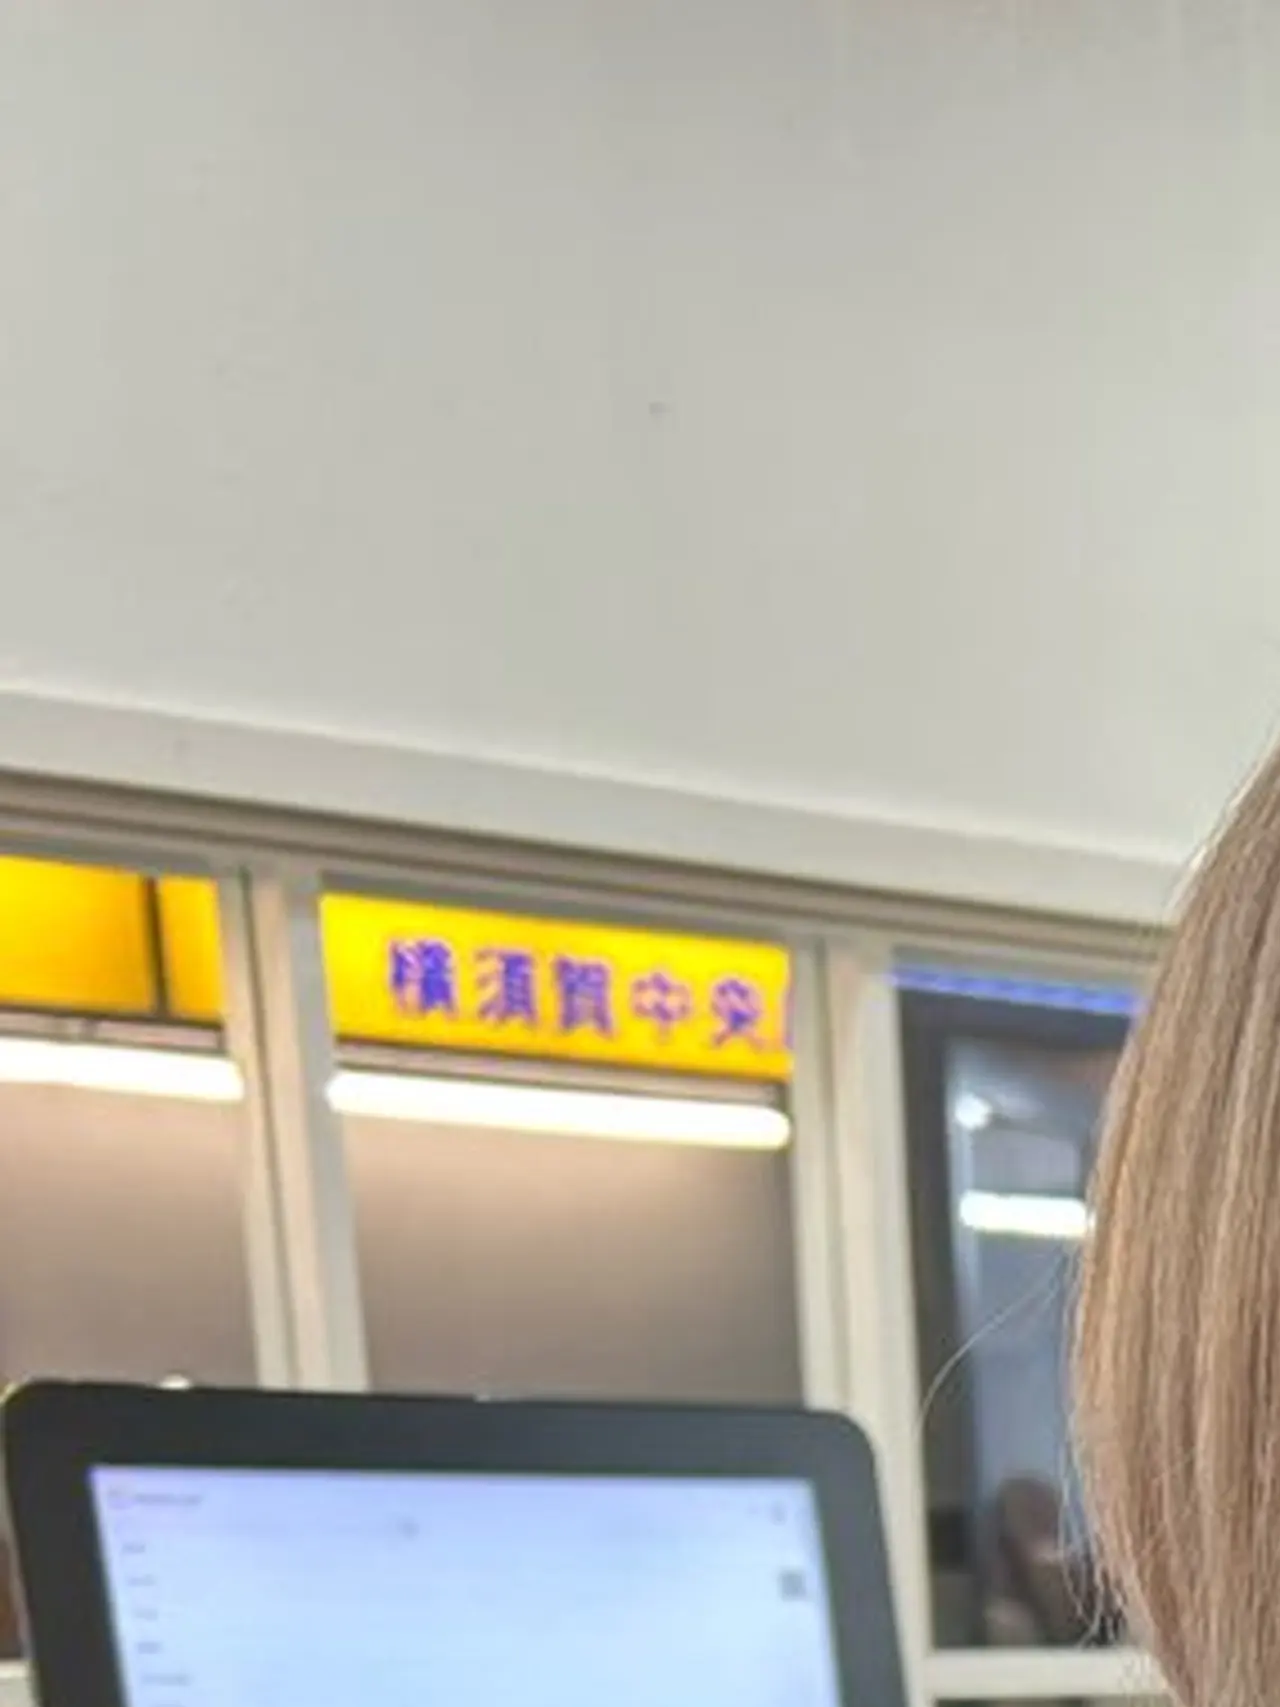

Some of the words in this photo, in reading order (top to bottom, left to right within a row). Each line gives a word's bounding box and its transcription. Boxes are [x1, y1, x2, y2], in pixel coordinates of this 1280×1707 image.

[388, 938, 794, 1050] 横須賀中央
